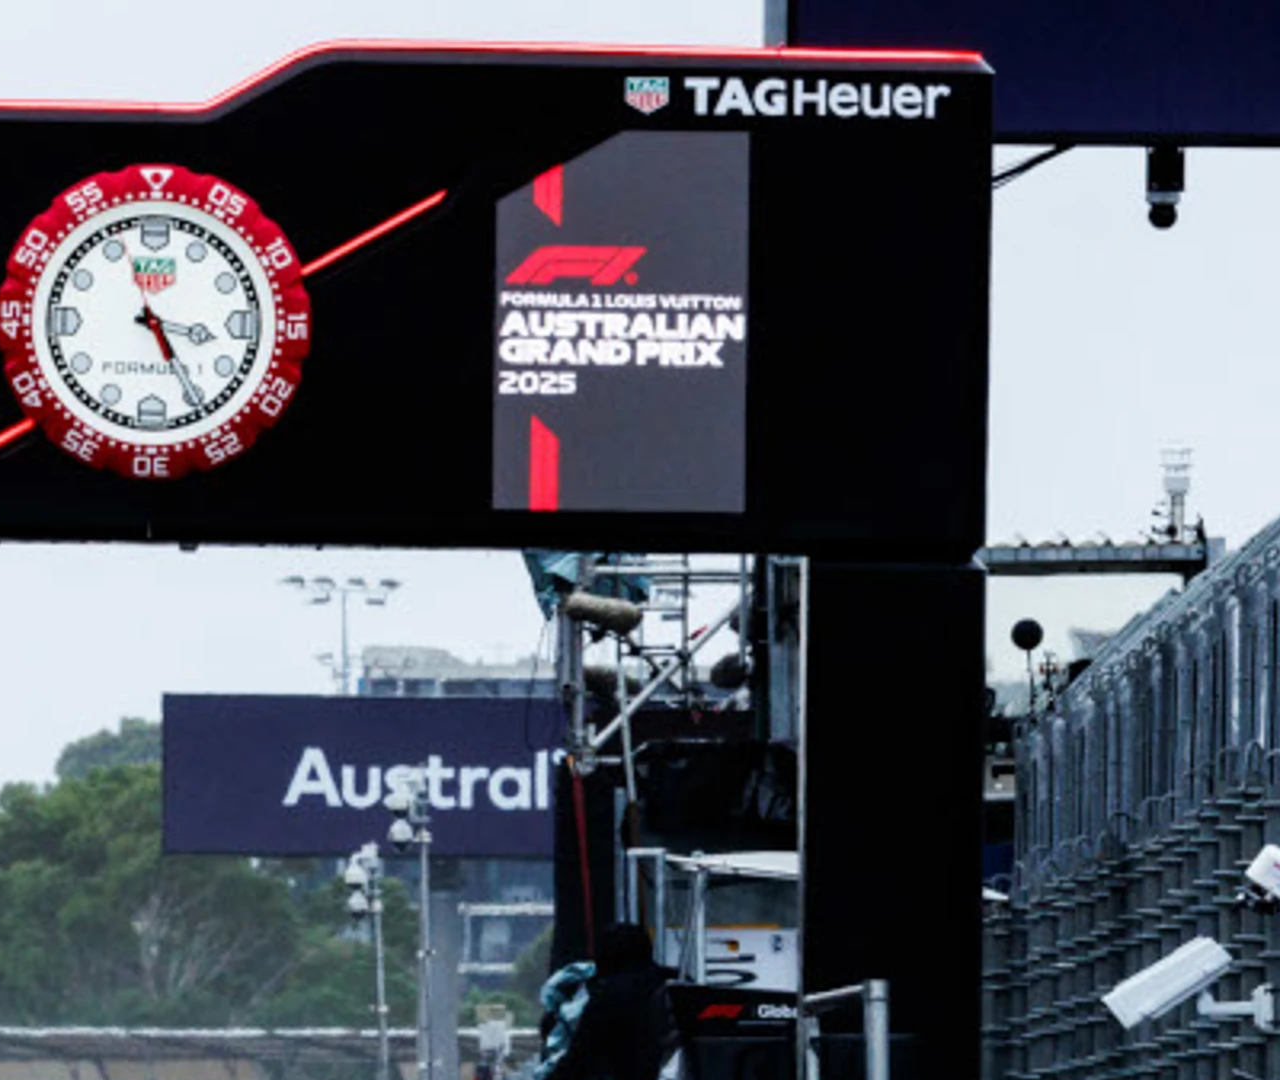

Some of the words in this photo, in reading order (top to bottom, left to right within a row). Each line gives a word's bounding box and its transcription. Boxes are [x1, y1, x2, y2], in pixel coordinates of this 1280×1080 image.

[500, 291, 590, 308] FORMULA
[591, 293, 602, 308] 1
[605, 294, 657, 309] LOUIS
[658, 294, 743, 310] VUITTON
[498, 310, 746, 341] AUSTRALIAN
[498, 338, 632, 366] GRAND
[636, 340, 724, 368] PRIX
[498, 371, 578, 395] 2025
[282, 746, 568, 811] Austral
